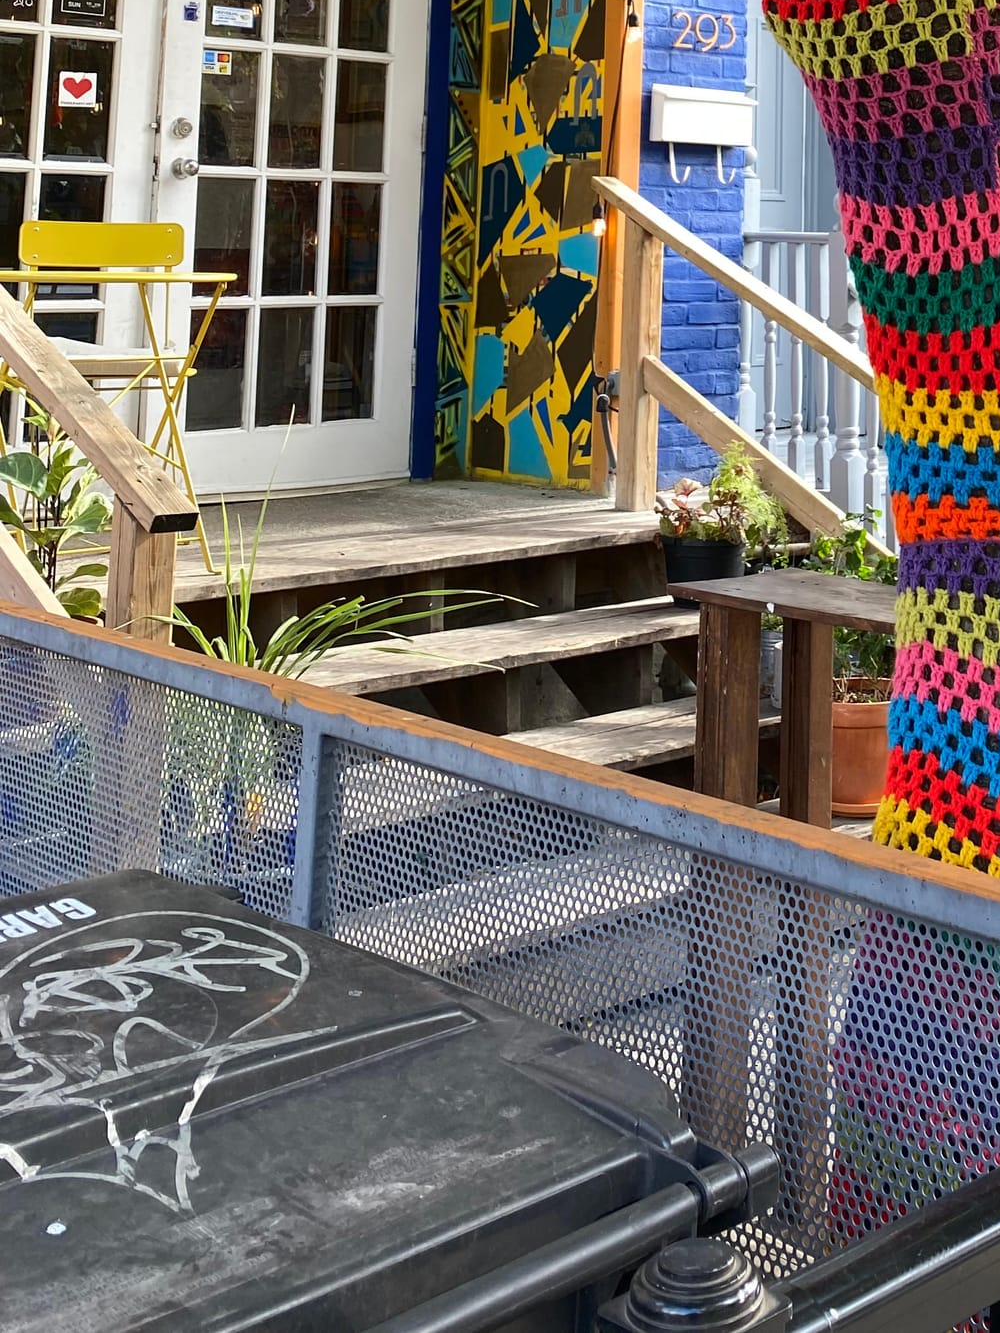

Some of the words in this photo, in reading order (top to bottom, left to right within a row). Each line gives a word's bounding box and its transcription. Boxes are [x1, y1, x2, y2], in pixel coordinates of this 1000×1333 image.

[67, 0, 82, 8] SUN
[672, 11, 737, 52] 293
[0, 898, 96, 944] GAR
